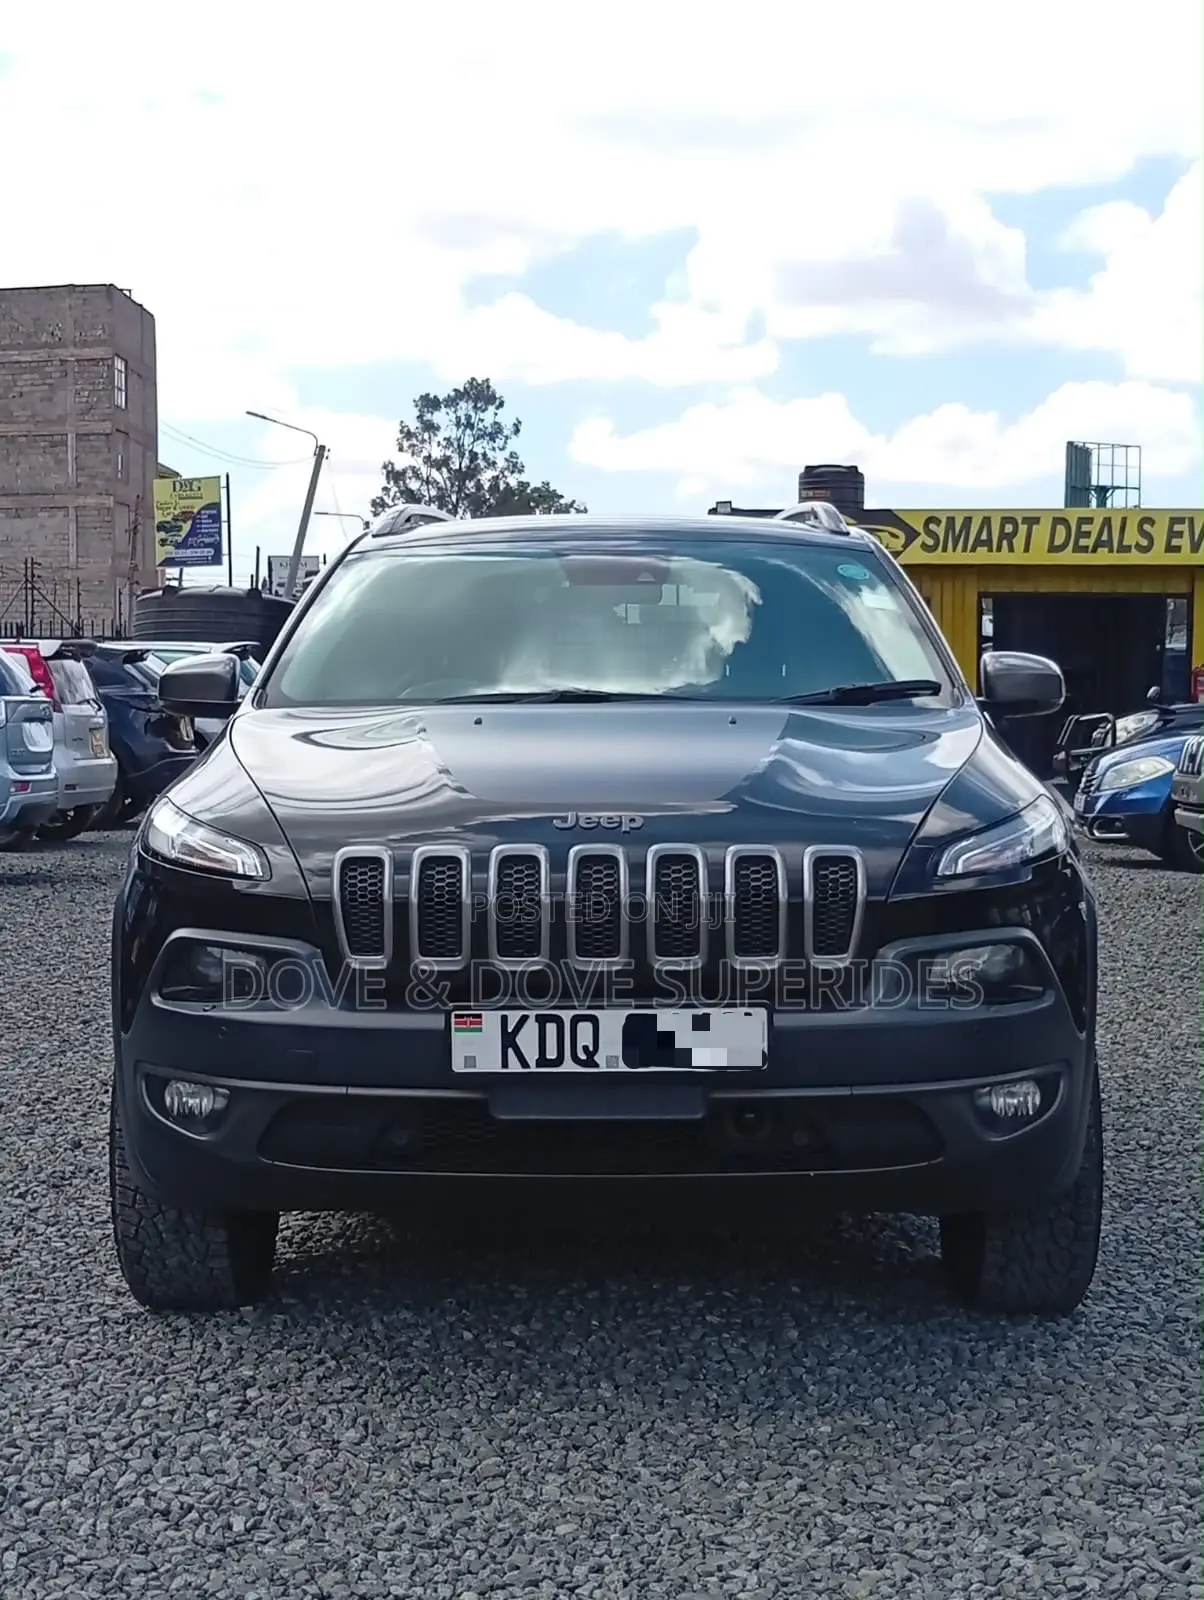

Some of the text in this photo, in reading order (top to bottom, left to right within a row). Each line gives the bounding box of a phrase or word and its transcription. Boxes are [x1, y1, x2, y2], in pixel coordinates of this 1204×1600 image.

[919, 515, 1041, 553] SMART
[1046, 515, 1157, 553] DEALS
[552, 811, 644, 833] Jeep
[500, 1013, 600, 1069] KDQ
